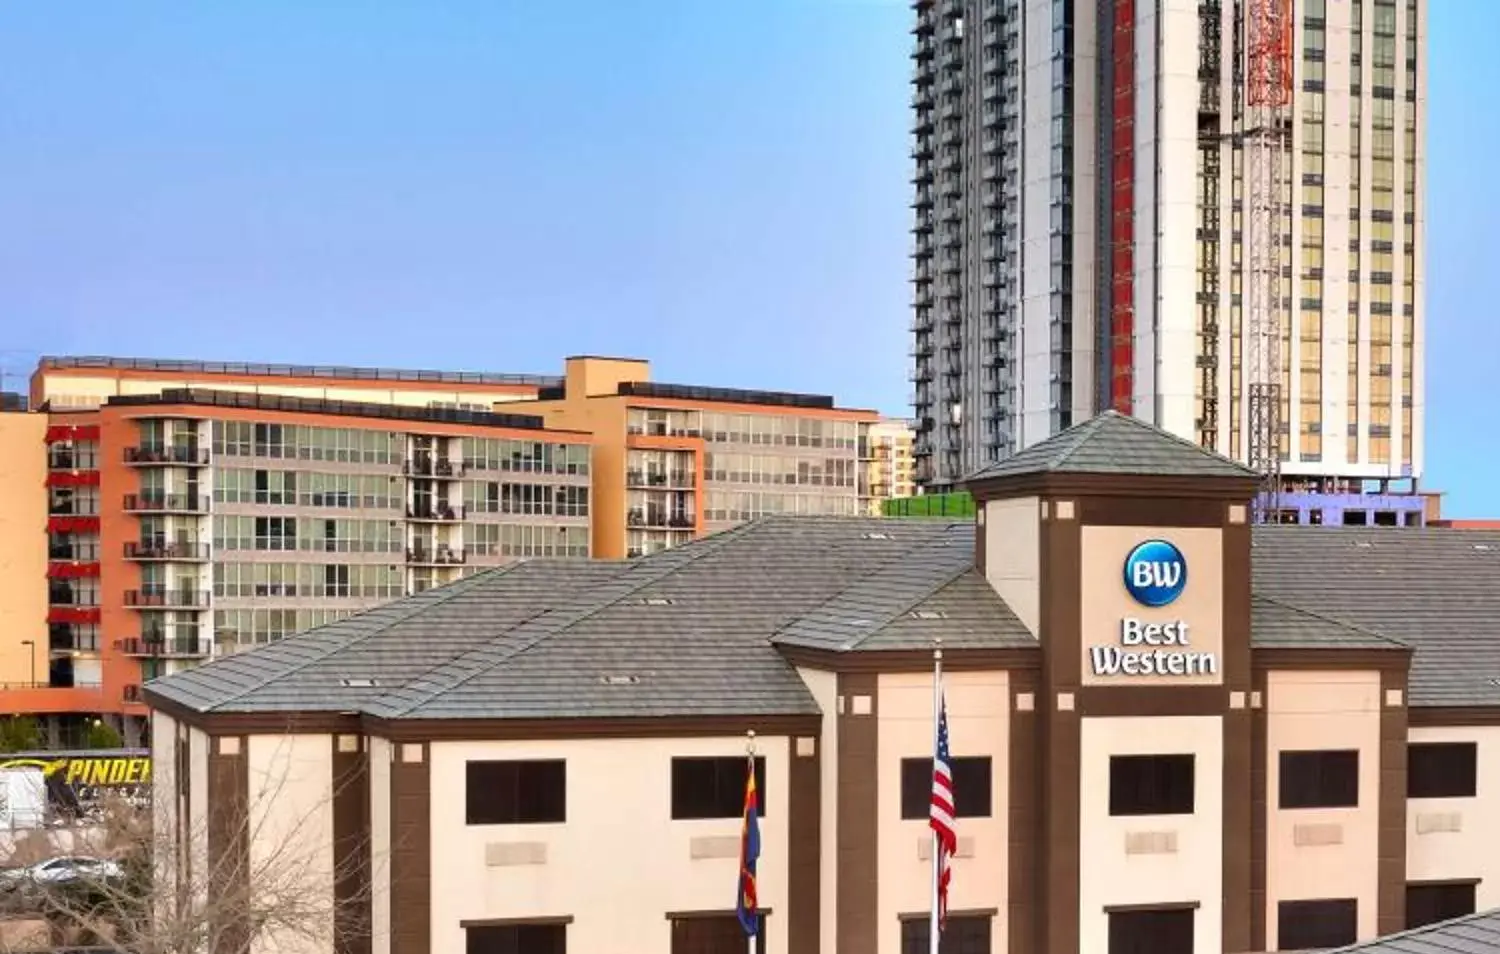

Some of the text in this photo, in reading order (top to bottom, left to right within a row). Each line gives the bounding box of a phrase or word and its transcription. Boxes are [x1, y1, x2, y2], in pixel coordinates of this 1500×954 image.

[1133, 561, 1181, 588] BW
[1121, 617, 1189, 645] Best
[1091, 647, 1216, 675] Western
